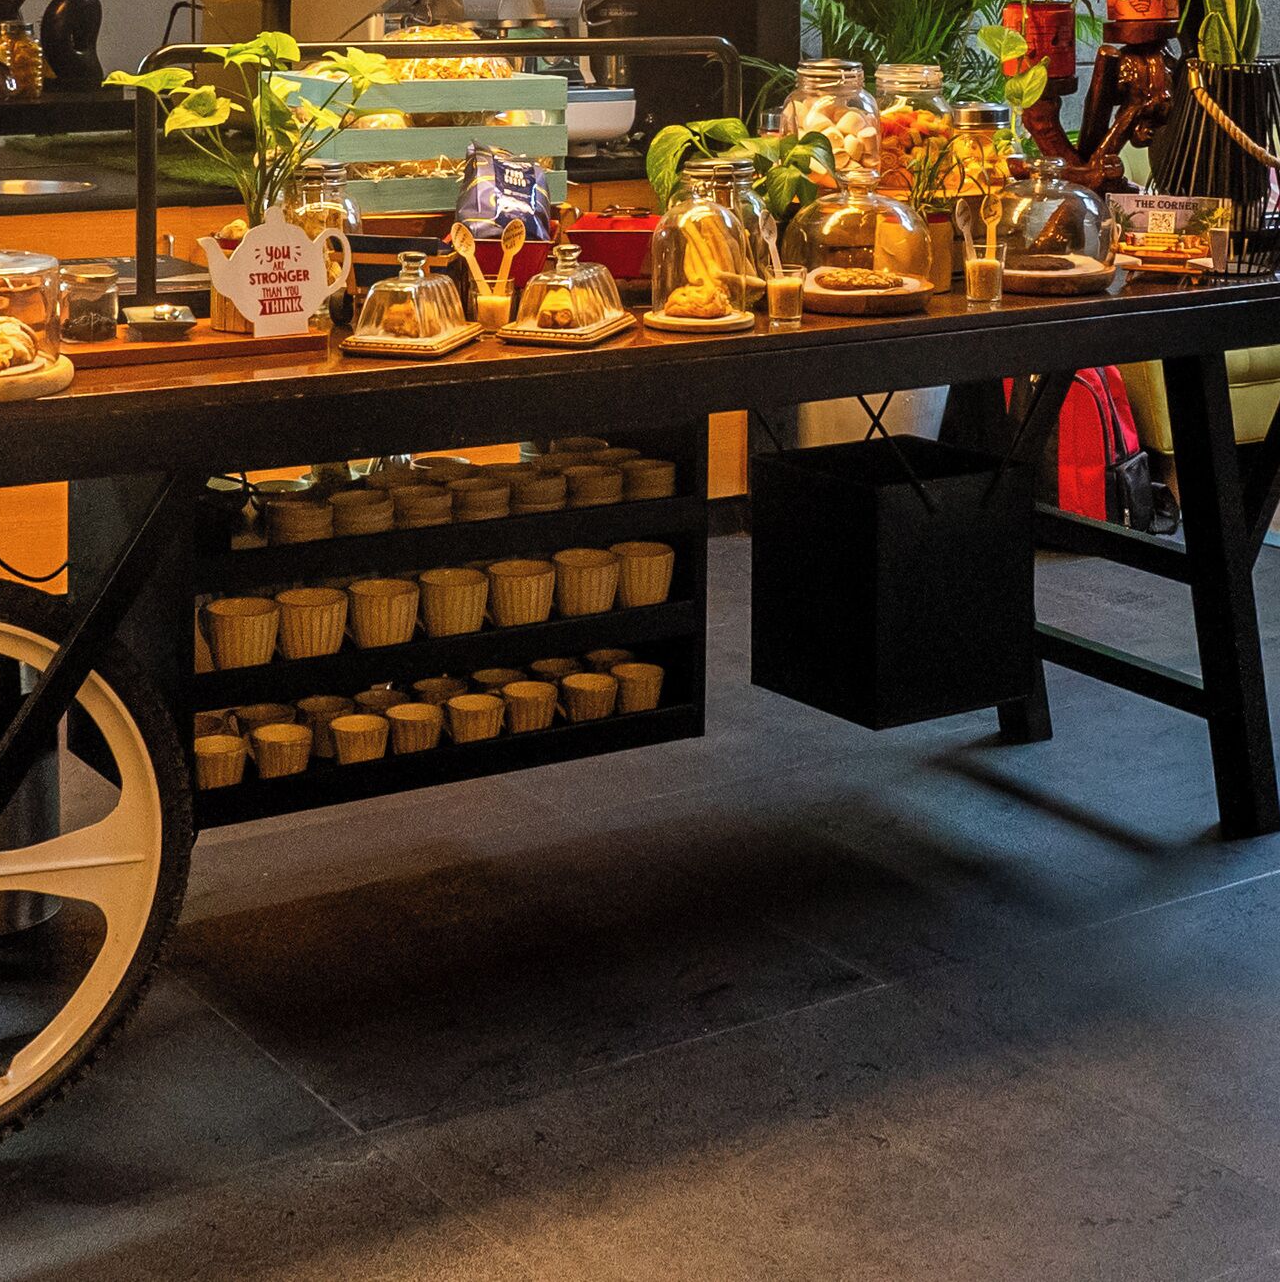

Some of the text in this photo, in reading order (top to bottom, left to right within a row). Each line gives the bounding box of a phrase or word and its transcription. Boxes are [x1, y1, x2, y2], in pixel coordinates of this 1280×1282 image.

[1135, 199, 1200, 211] THE CORNER
[265, 245, 291, 262] YOU
[249, 269, 310, 285] STRONGER
[262, 285, 300, 298] THAN YOU
[263, 298, 301, 314] THINK
